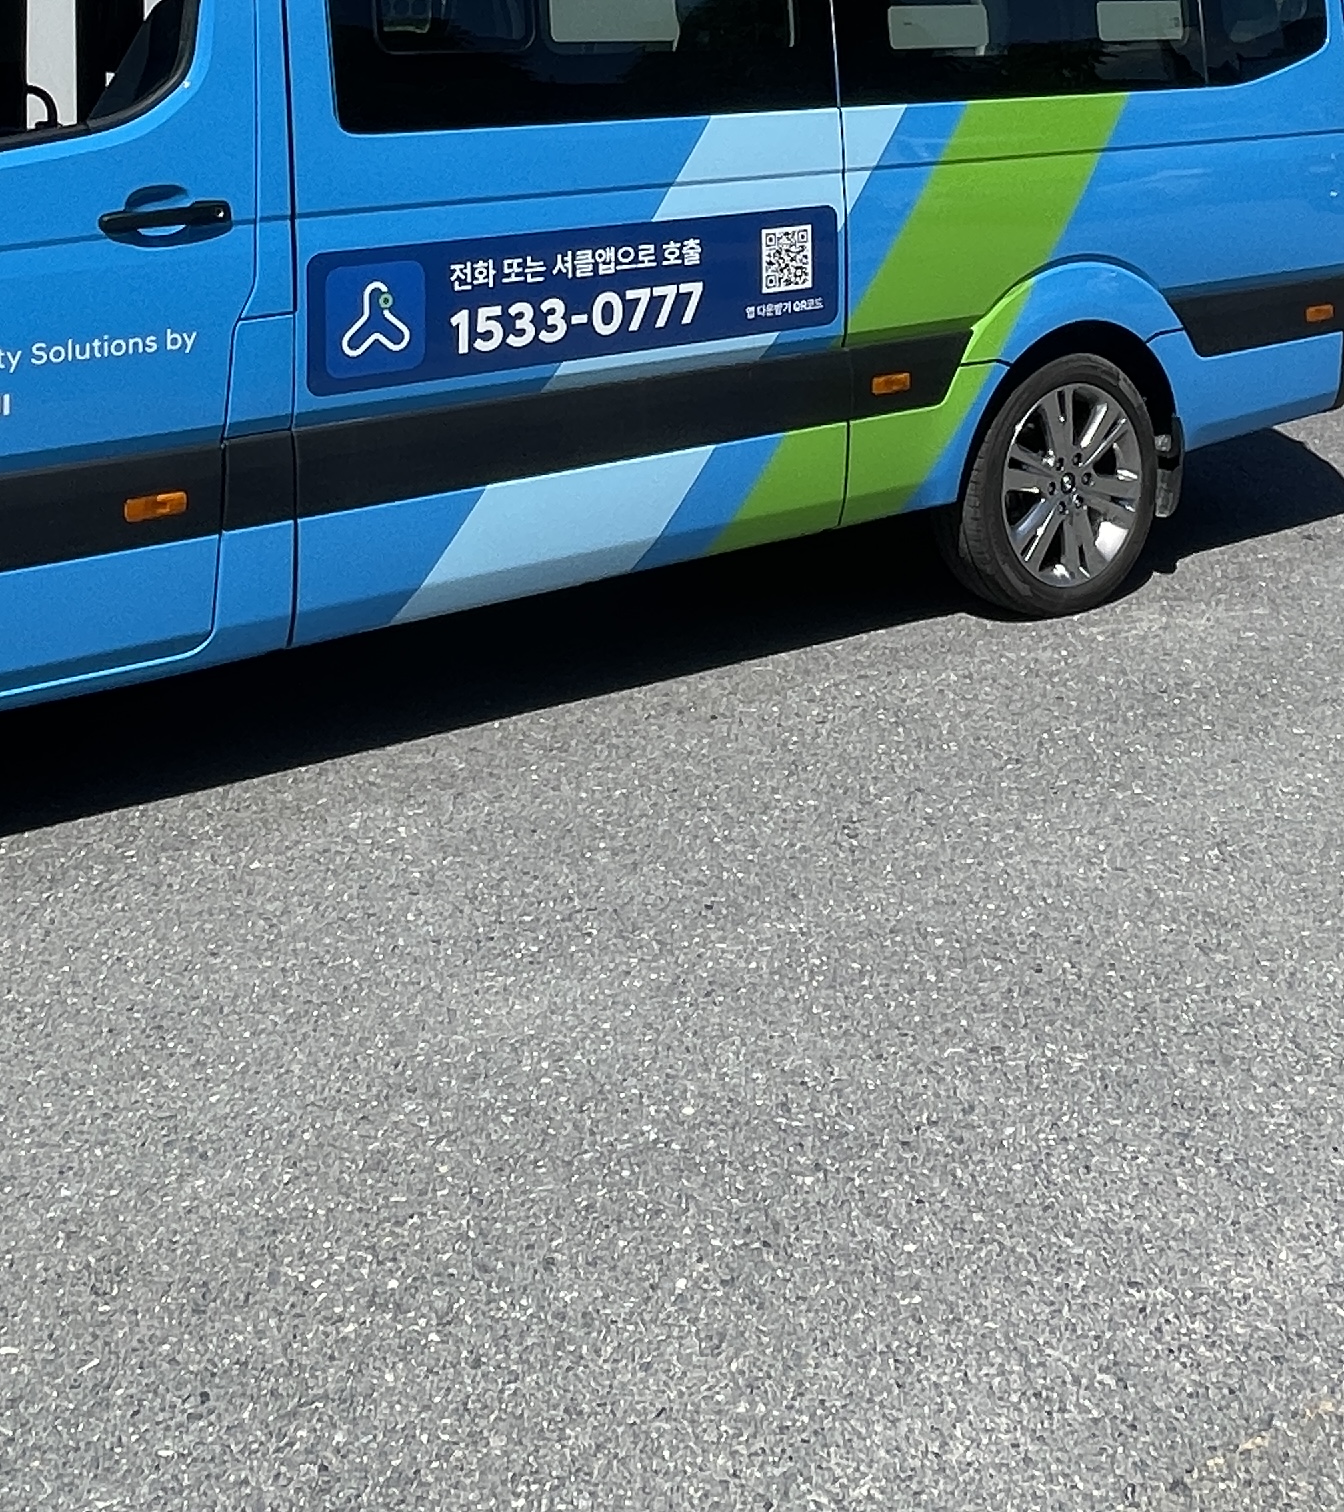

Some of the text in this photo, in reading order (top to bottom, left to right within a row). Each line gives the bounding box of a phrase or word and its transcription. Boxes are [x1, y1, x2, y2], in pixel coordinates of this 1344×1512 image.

[450, 238, 703, 292] 전화 또는 셔클앱으로 호출
[450, 281, 704, 354] 1533-0777
[31, 335, 158, 365] Solutions
[166, 328, 197, 354] by
